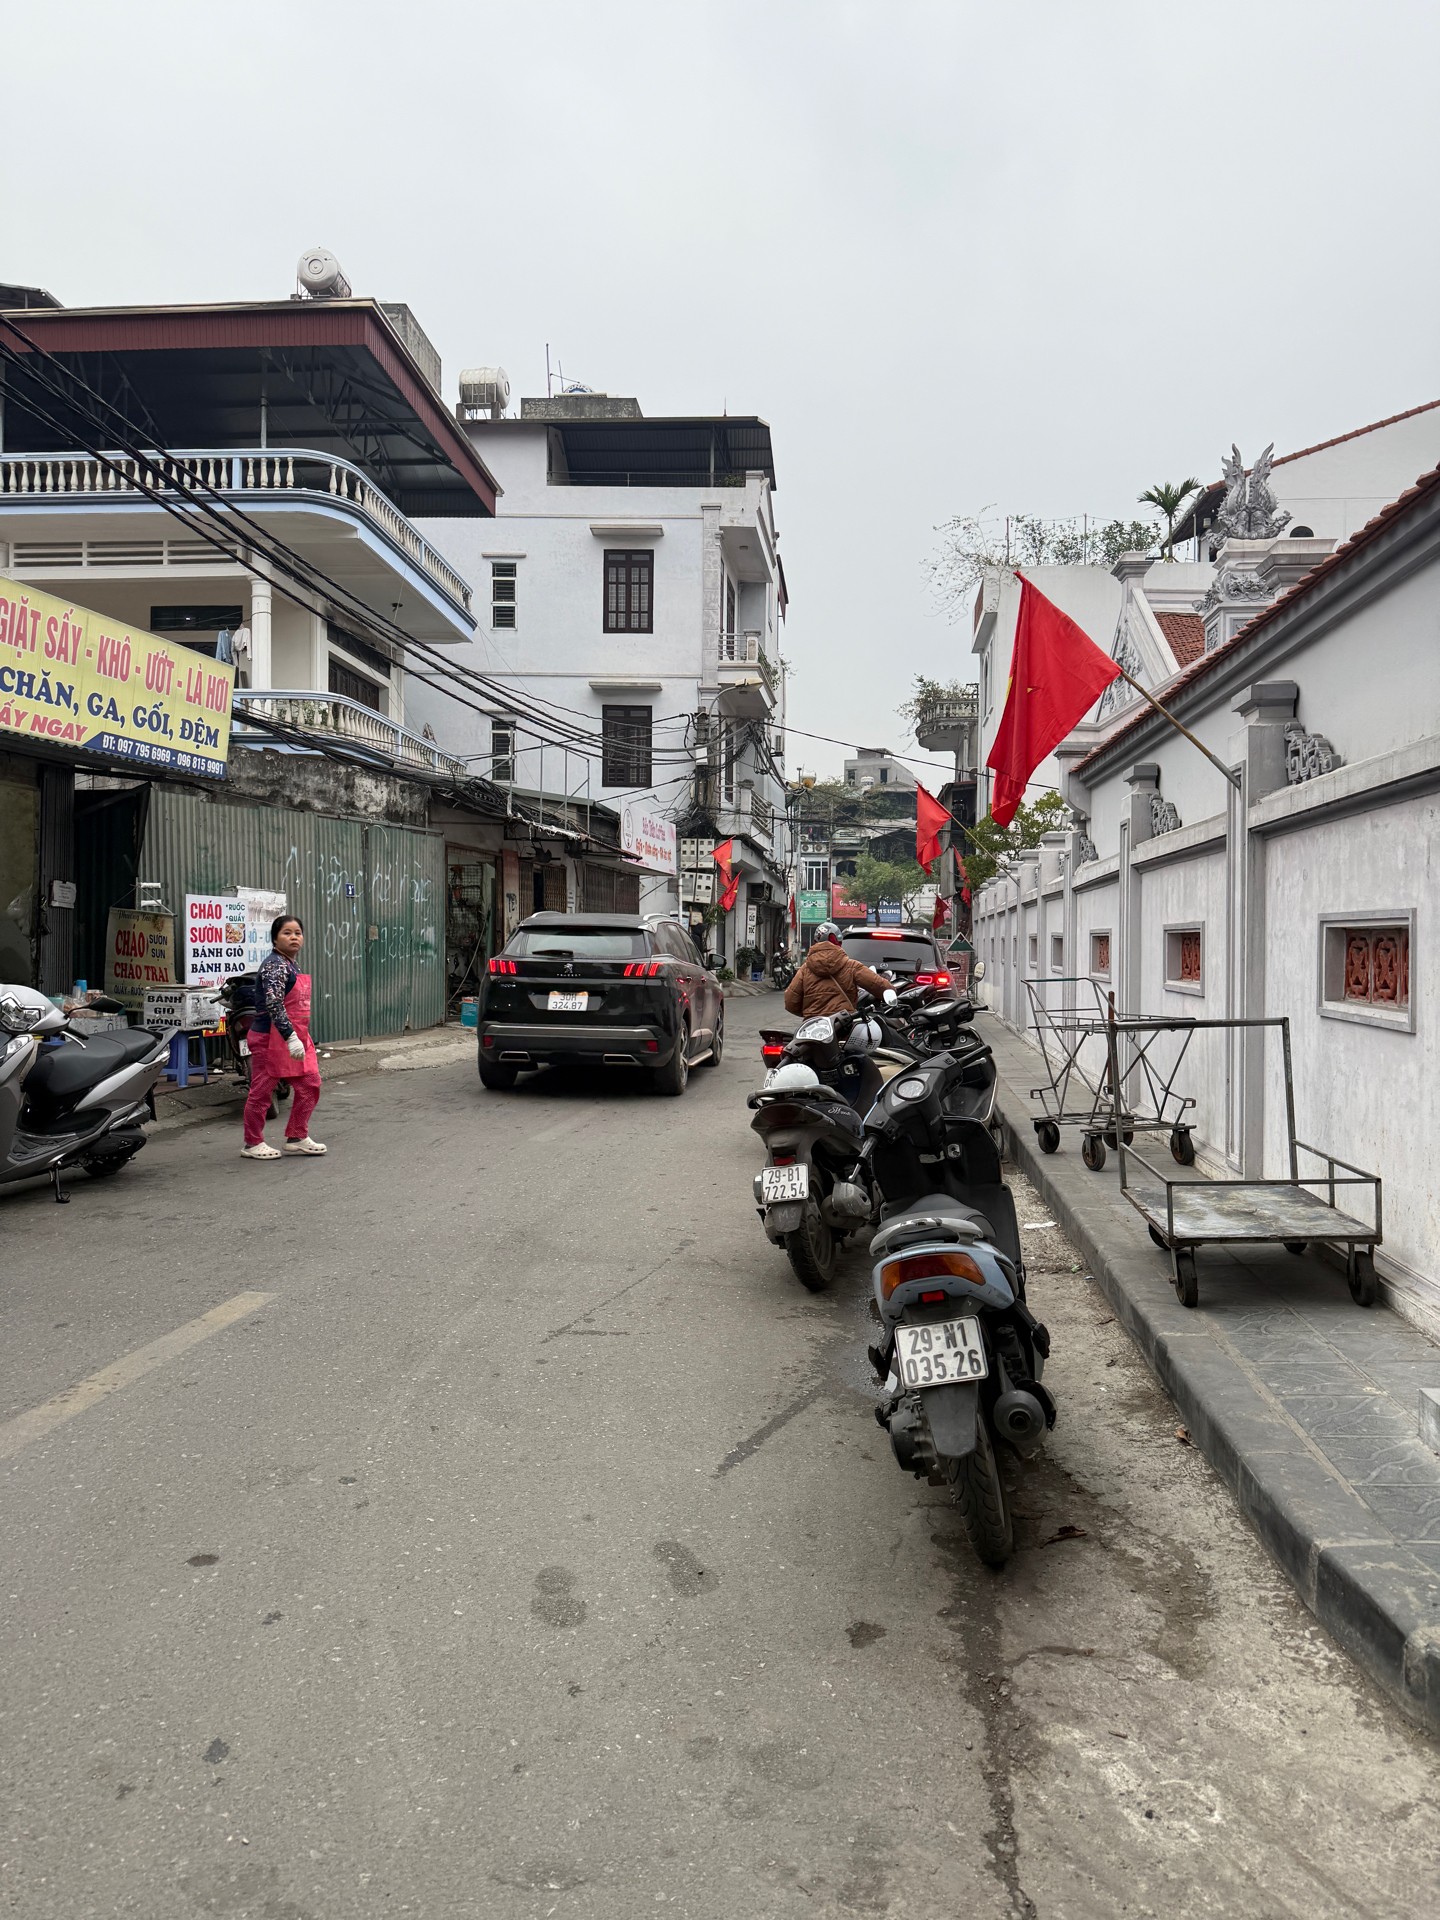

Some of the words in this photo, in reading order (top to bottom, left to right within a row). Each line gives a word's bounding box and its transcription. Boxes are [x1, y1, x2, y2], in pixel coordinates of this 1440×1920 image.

[0, 596, 41, 658] GIẶT
[45, 608, 82, 666] SẤY
[97, 635, 131, 682] KHÔ
[146, 650, 174, 695] ƯỚT
[186, 663, 202, 706] LÀ
[206, 675, 229, 713] HƠI
[0, 666, 79, 716] CHĂN,
[87, 693, 125, 728] GA,
[133, 702, 173, 741] GỐI,
[179, 717, 219, 749] ĐỆM
[30, 714, 88, 741] NGAY
[102, 734, 116, 750] ĐT:
[117, 739, 133, 753] 097
[135, 743, 150, 759] 795
[151, 747, 171, 762] 6969
[177, 753, 191, 767] 096
[192, 757, 206, 770] 815
[207, 761, 223, 775] 9991
[190, 900, 222, 920] CHÁO
[115, 923, 145, 958] CHÁO
[190, 923, 223, 943] SƯỜN
[151, 948, 165, 961] SỤN
[192, 945, 223, 958] BÁNH
[225, 945, 244, 957] GIÒ
[113, 958, 142, 979] CHÁO
[144, 965, 169, 983] TRAI
[191, 961, 221, 973] BÁNH
[224, 962, 246, 972] BAO
[147, 994, 182, 1004] BÁNH
[552, 1001, 583, 1010] 324.87
[154, 1006, 175, 1015] GIÒ
[768, 1167, 801, 1184] 29-B1
[764, 1183, 806, 1201] 722.54
[908, 1321, 969, 1355] 29-N1
[905, 1348, 983, 1385] 035.26
